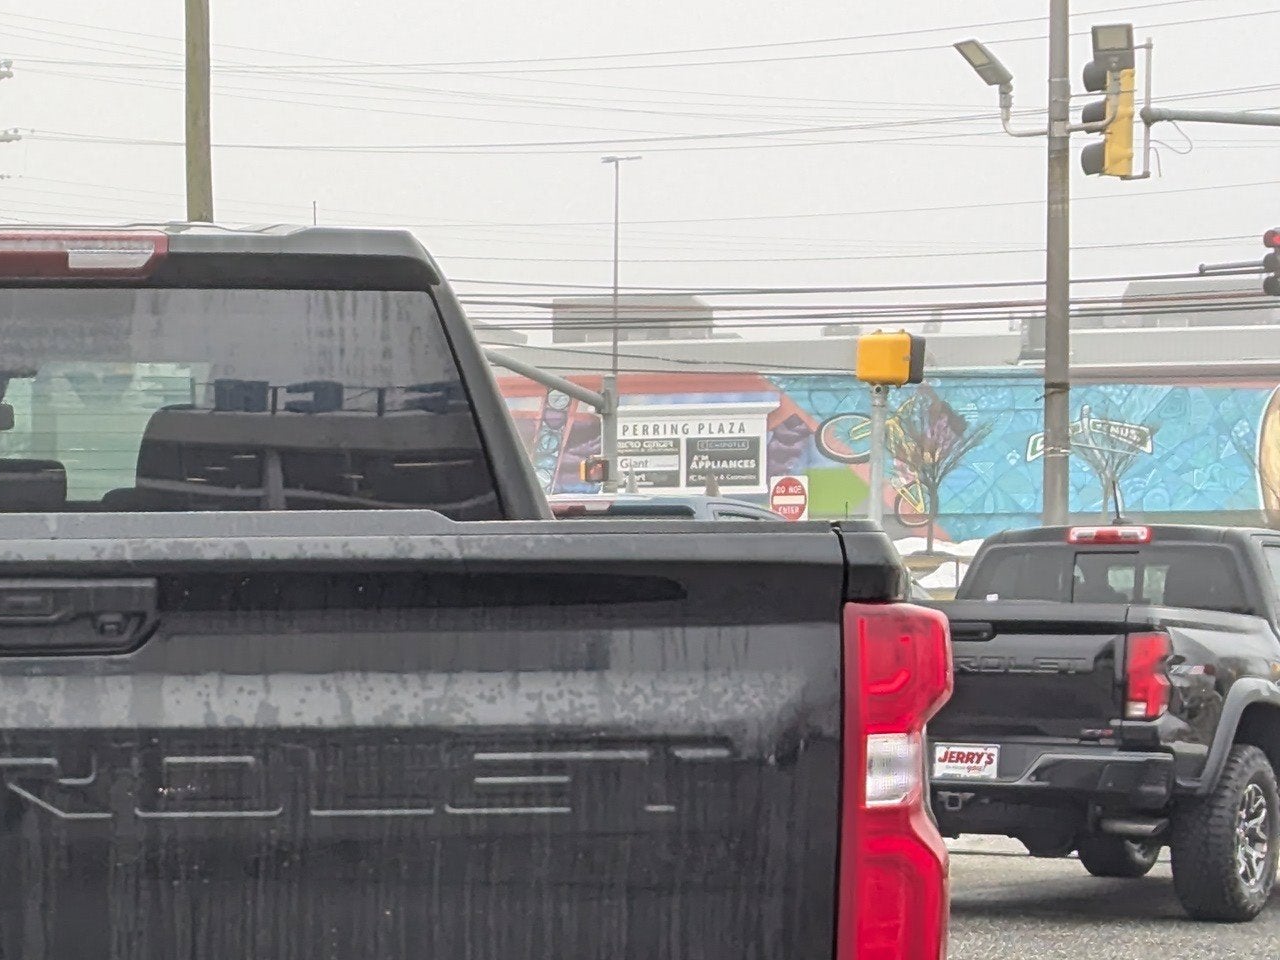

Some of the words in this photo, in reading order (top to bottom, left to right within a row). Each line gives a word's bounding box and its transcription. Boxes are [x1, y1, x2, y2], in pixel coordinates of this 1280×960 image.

[622, 423, 690, 436] PERRING
[698, 422, 746, 434] PLAZA
[690, 459, 756, 470] APPLIANCES
[937, 750, 996, 765] JERRY'S
